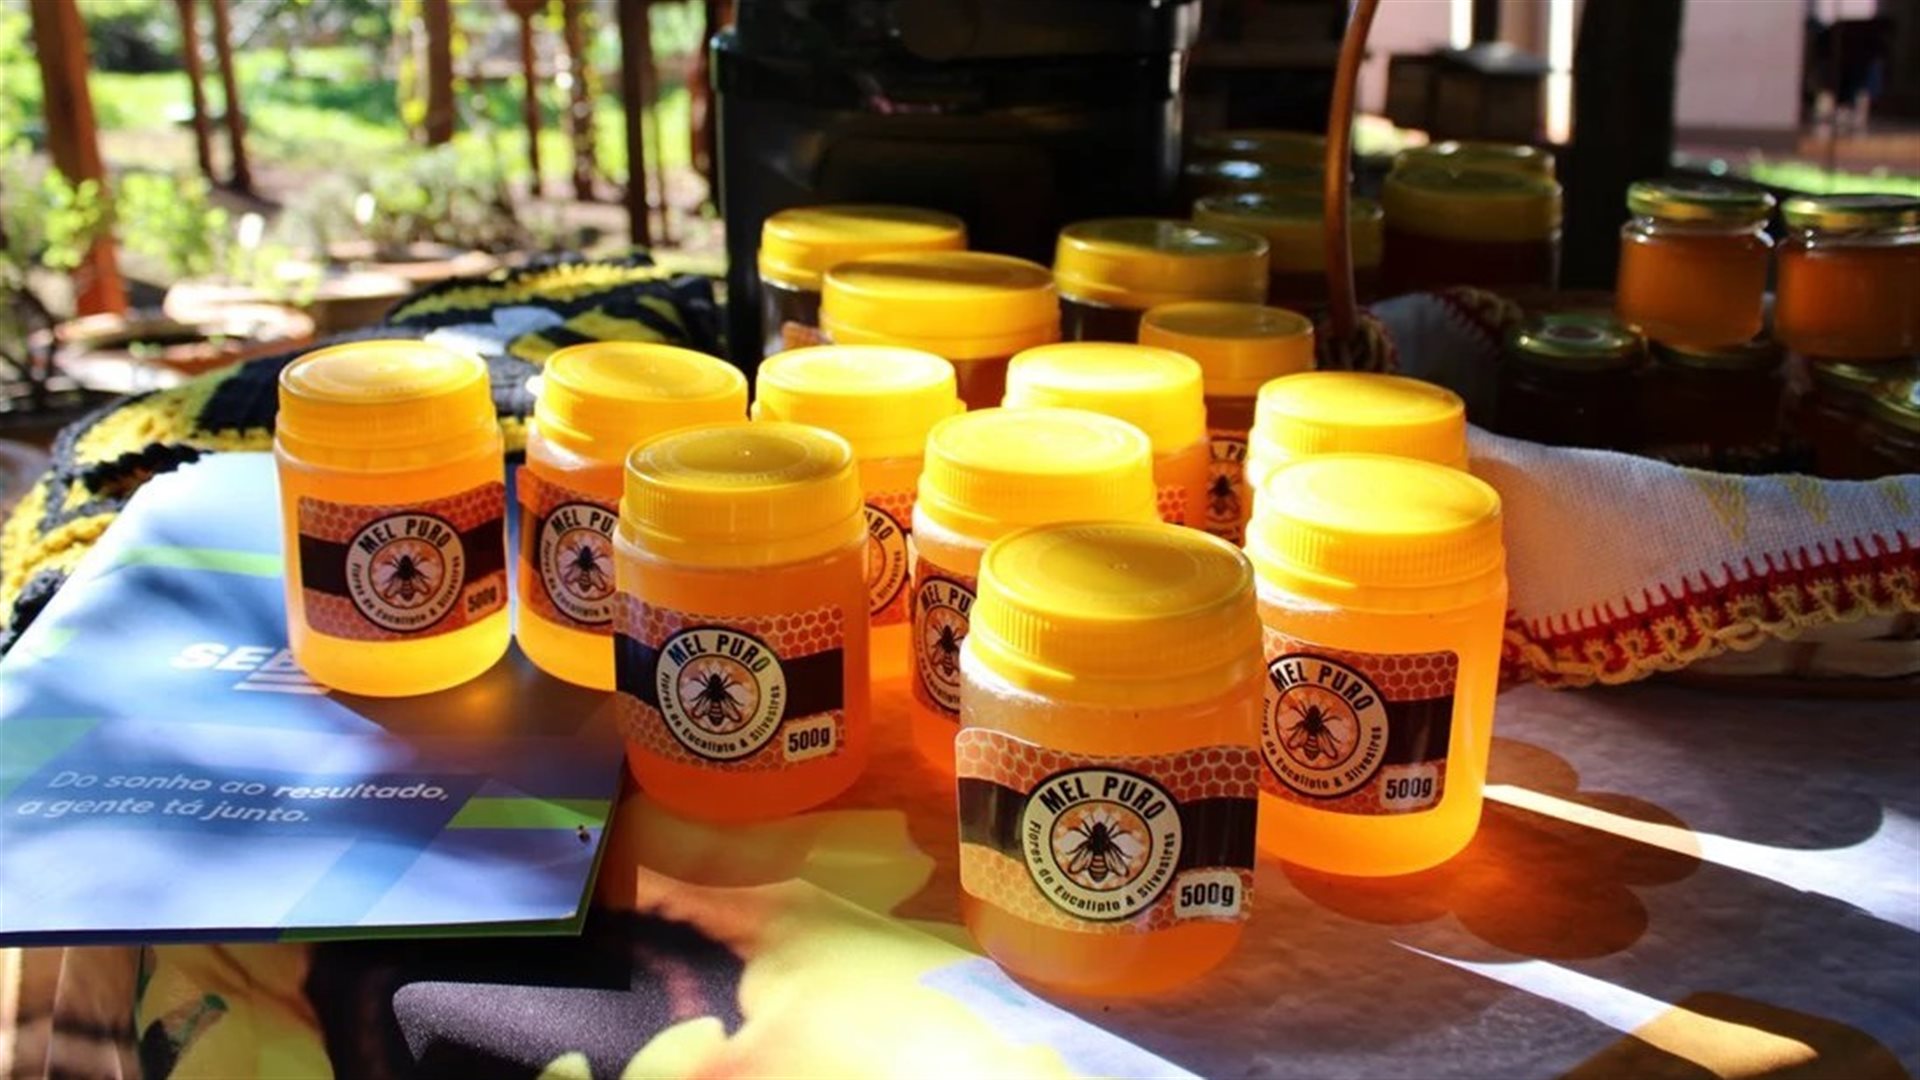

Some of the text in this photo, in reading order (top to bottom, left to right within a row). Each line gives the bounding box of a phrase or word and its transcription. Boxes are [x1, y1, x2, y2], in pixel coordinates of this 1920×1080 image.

[358, 518, 452, 555] MEL PURO
[551, 509, 613, 536] MEL PU
[865, 512, 893, 541] RO
[949, 586, 972, 612] PU
[667, 634, 771, 673] MEL PURO
[1270, 661, 1374, 712] MEL PURO
[660, 671, 781, 753] Flores de Eucalipto & Silvestres
[788, 726, 831, 753] 500g
[1266, 740, 1277, 757] de
[1277, 756, 1331, 790] Eucalipto
[1334, 776, 1343, 789] &
[1344, 725, 1382, 782] Silvestres
[48, 769, 449, 801] Do sonho ao resultado,
[1038, 775, 1167, 821] MEL PURO
[1385, 776, 1433, 800] 500g
[17, 797, 310, 822] a gente tá junto.
[1029, 819, 1176, 913] Flores de Eucalipto & Silvestres
[1180, 881, 1235, 908] 500g
